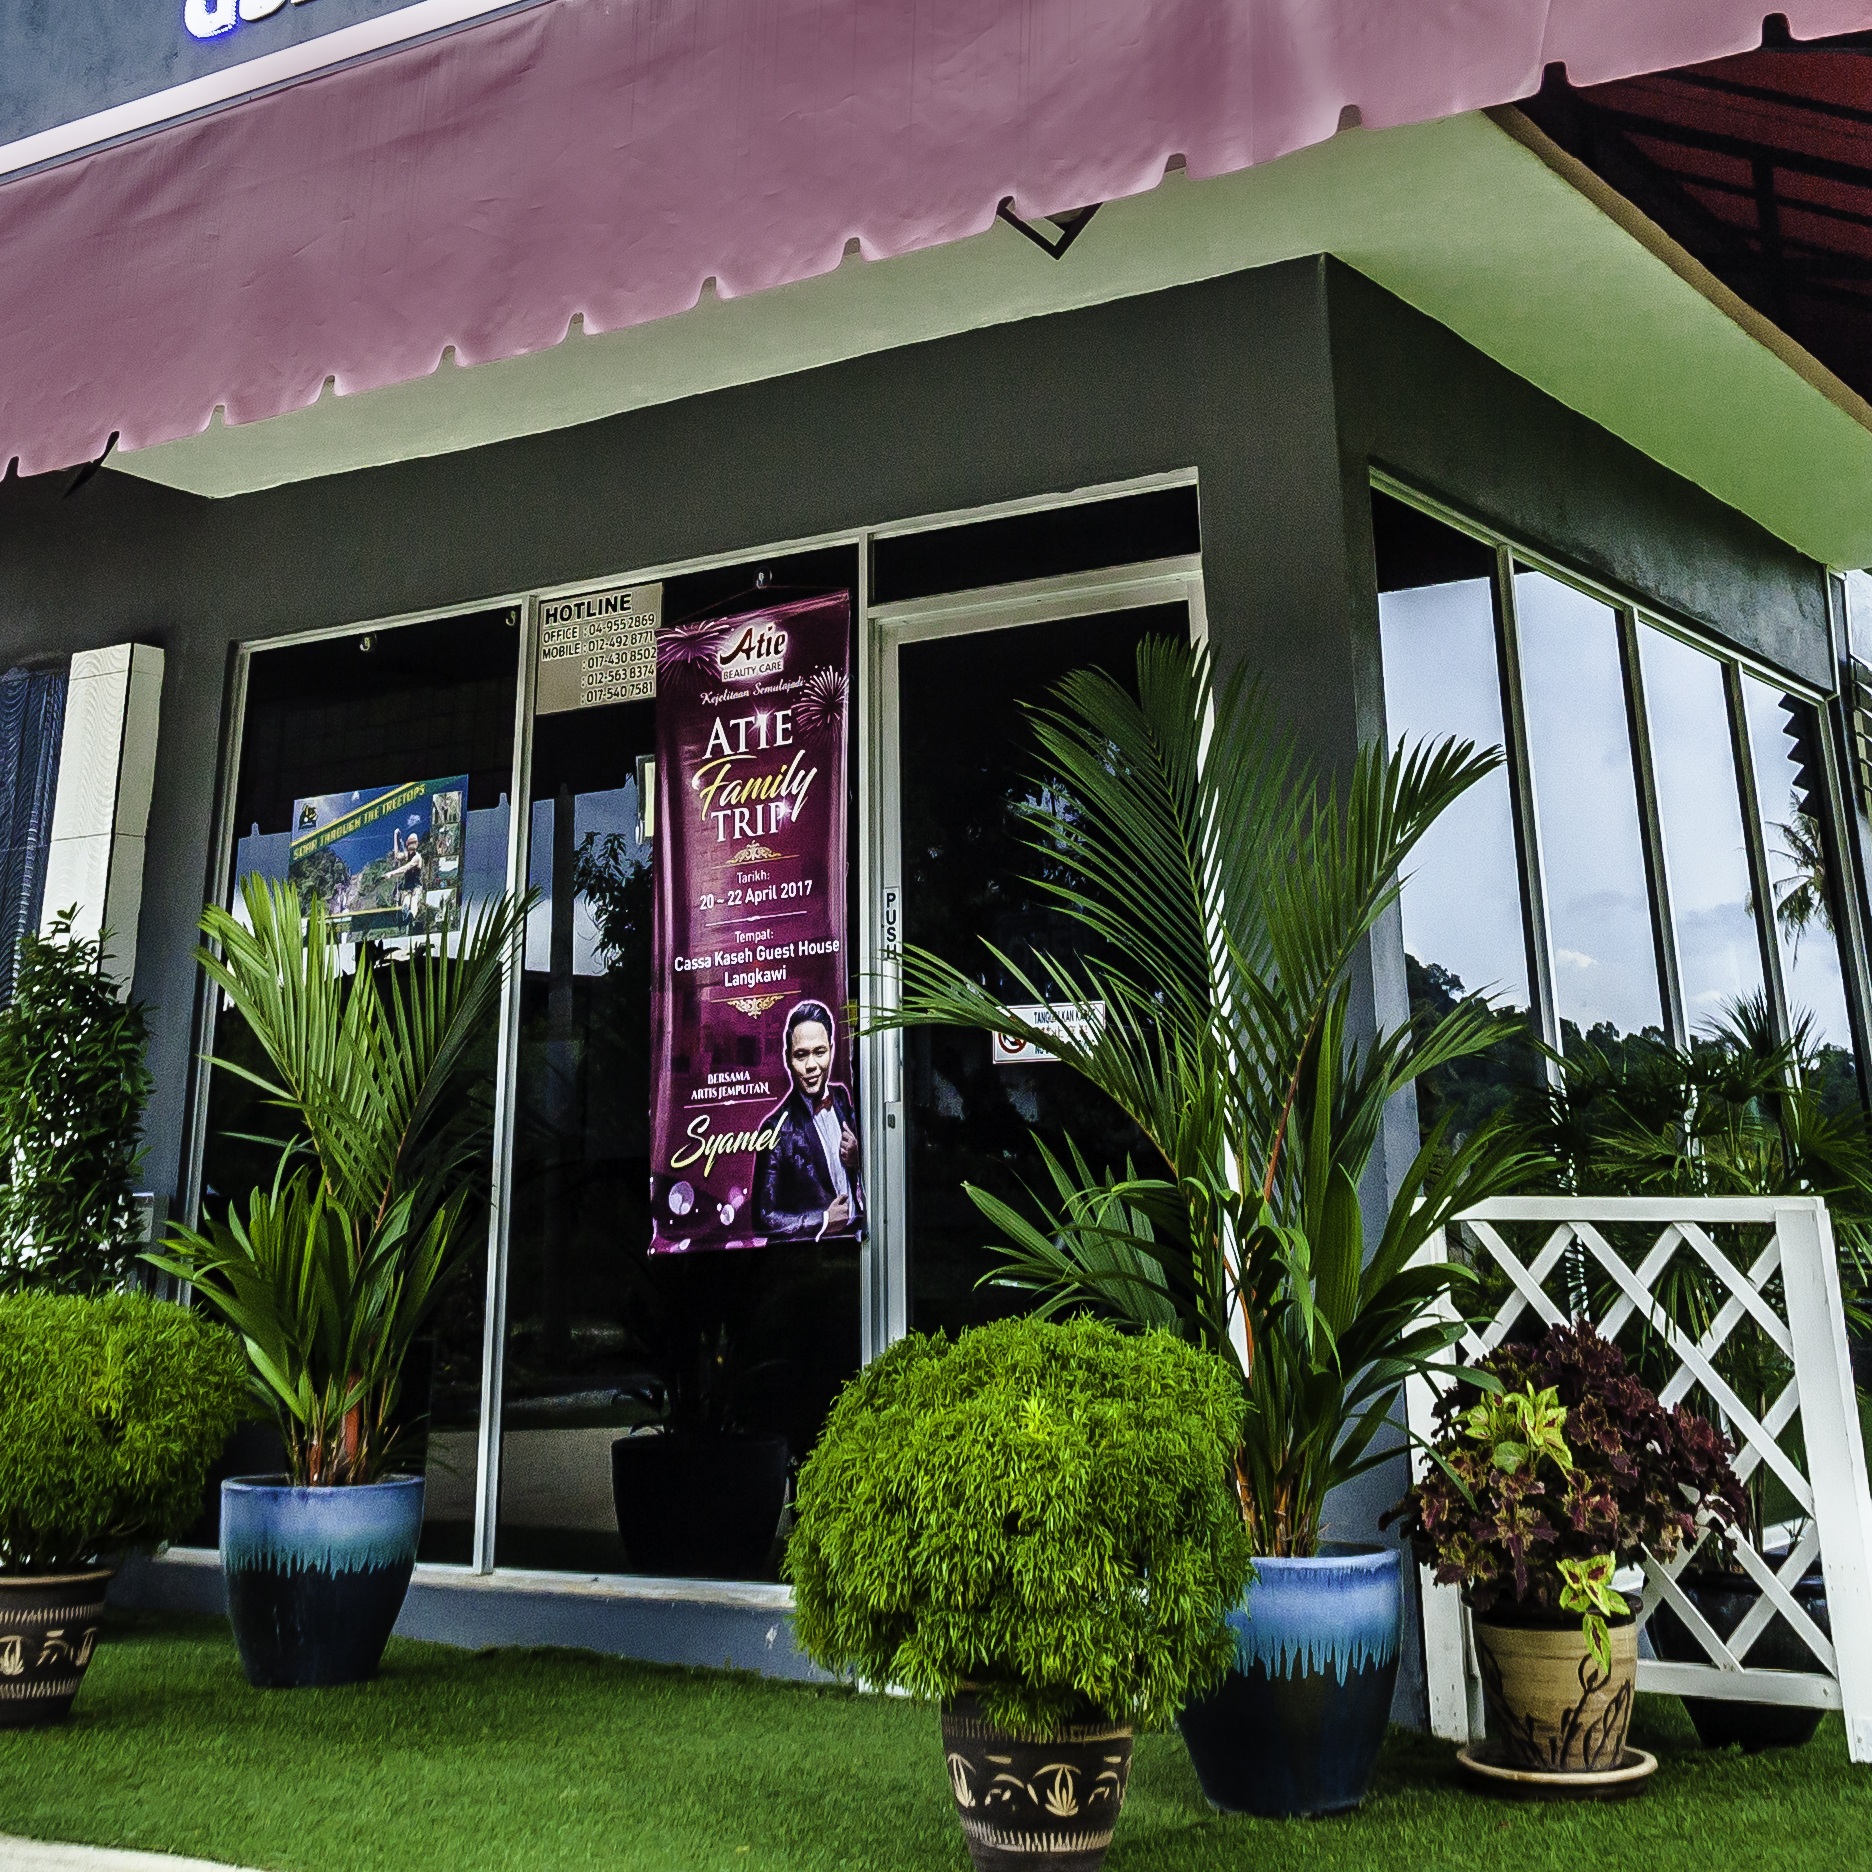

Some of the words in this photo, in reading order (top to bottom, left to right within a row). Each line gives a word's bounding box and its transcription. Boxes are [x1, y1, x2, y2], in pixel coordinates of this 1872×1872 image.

[545, 593, 632, 625] HOTLINE
[543, 627, 578, 643] OFFICE
[628, 613, 655, 628] 2869
[542, 643, 581, 660] MOBILE
[630, 630, 653, 645] 8771
[629, 646, 656, 661] 8502
[720, 626, 786, 665] Atie
[629, 664, 654, 678] 8374
[723, 667, 756, 680] BEAUTY
[759, 660, 782, 673] CARE
[629, 681, 653, 696] 7581
[702, 709, 793, 760] ATIE
[692, 749, 818, 822] Family
[364, 808, 379, 825] THE
[382, 784, 427, 815] TREETOPS
[710, 801, 790, 843] TRIP
[736, 869, 770, 884] Tarikh:
[699, 893, 714, 910] 20
[727, 889, 743, 906] 22
[744, 885, 777, 905] April
[780, 879, 813, 899] 2017
[734, 929, 774, 944] Tempat:
[886, 892, 897, 960] PUSH
[674, 956, 712, 972] Cassa
[714, 947, 753, 966] Kaseh
[756, 943, 795, 962] Guest
[798, 939, 840, 957] House
[724, 965, 787, 988] Langkawi
[690, 1087, 718, 1100] ARTIS
[718, 1081, 770, 1099] JEMPUTAN
[707, 1070, 750, 1085] BERSAMA
[670, 1110, 789, 1178] Syamel
